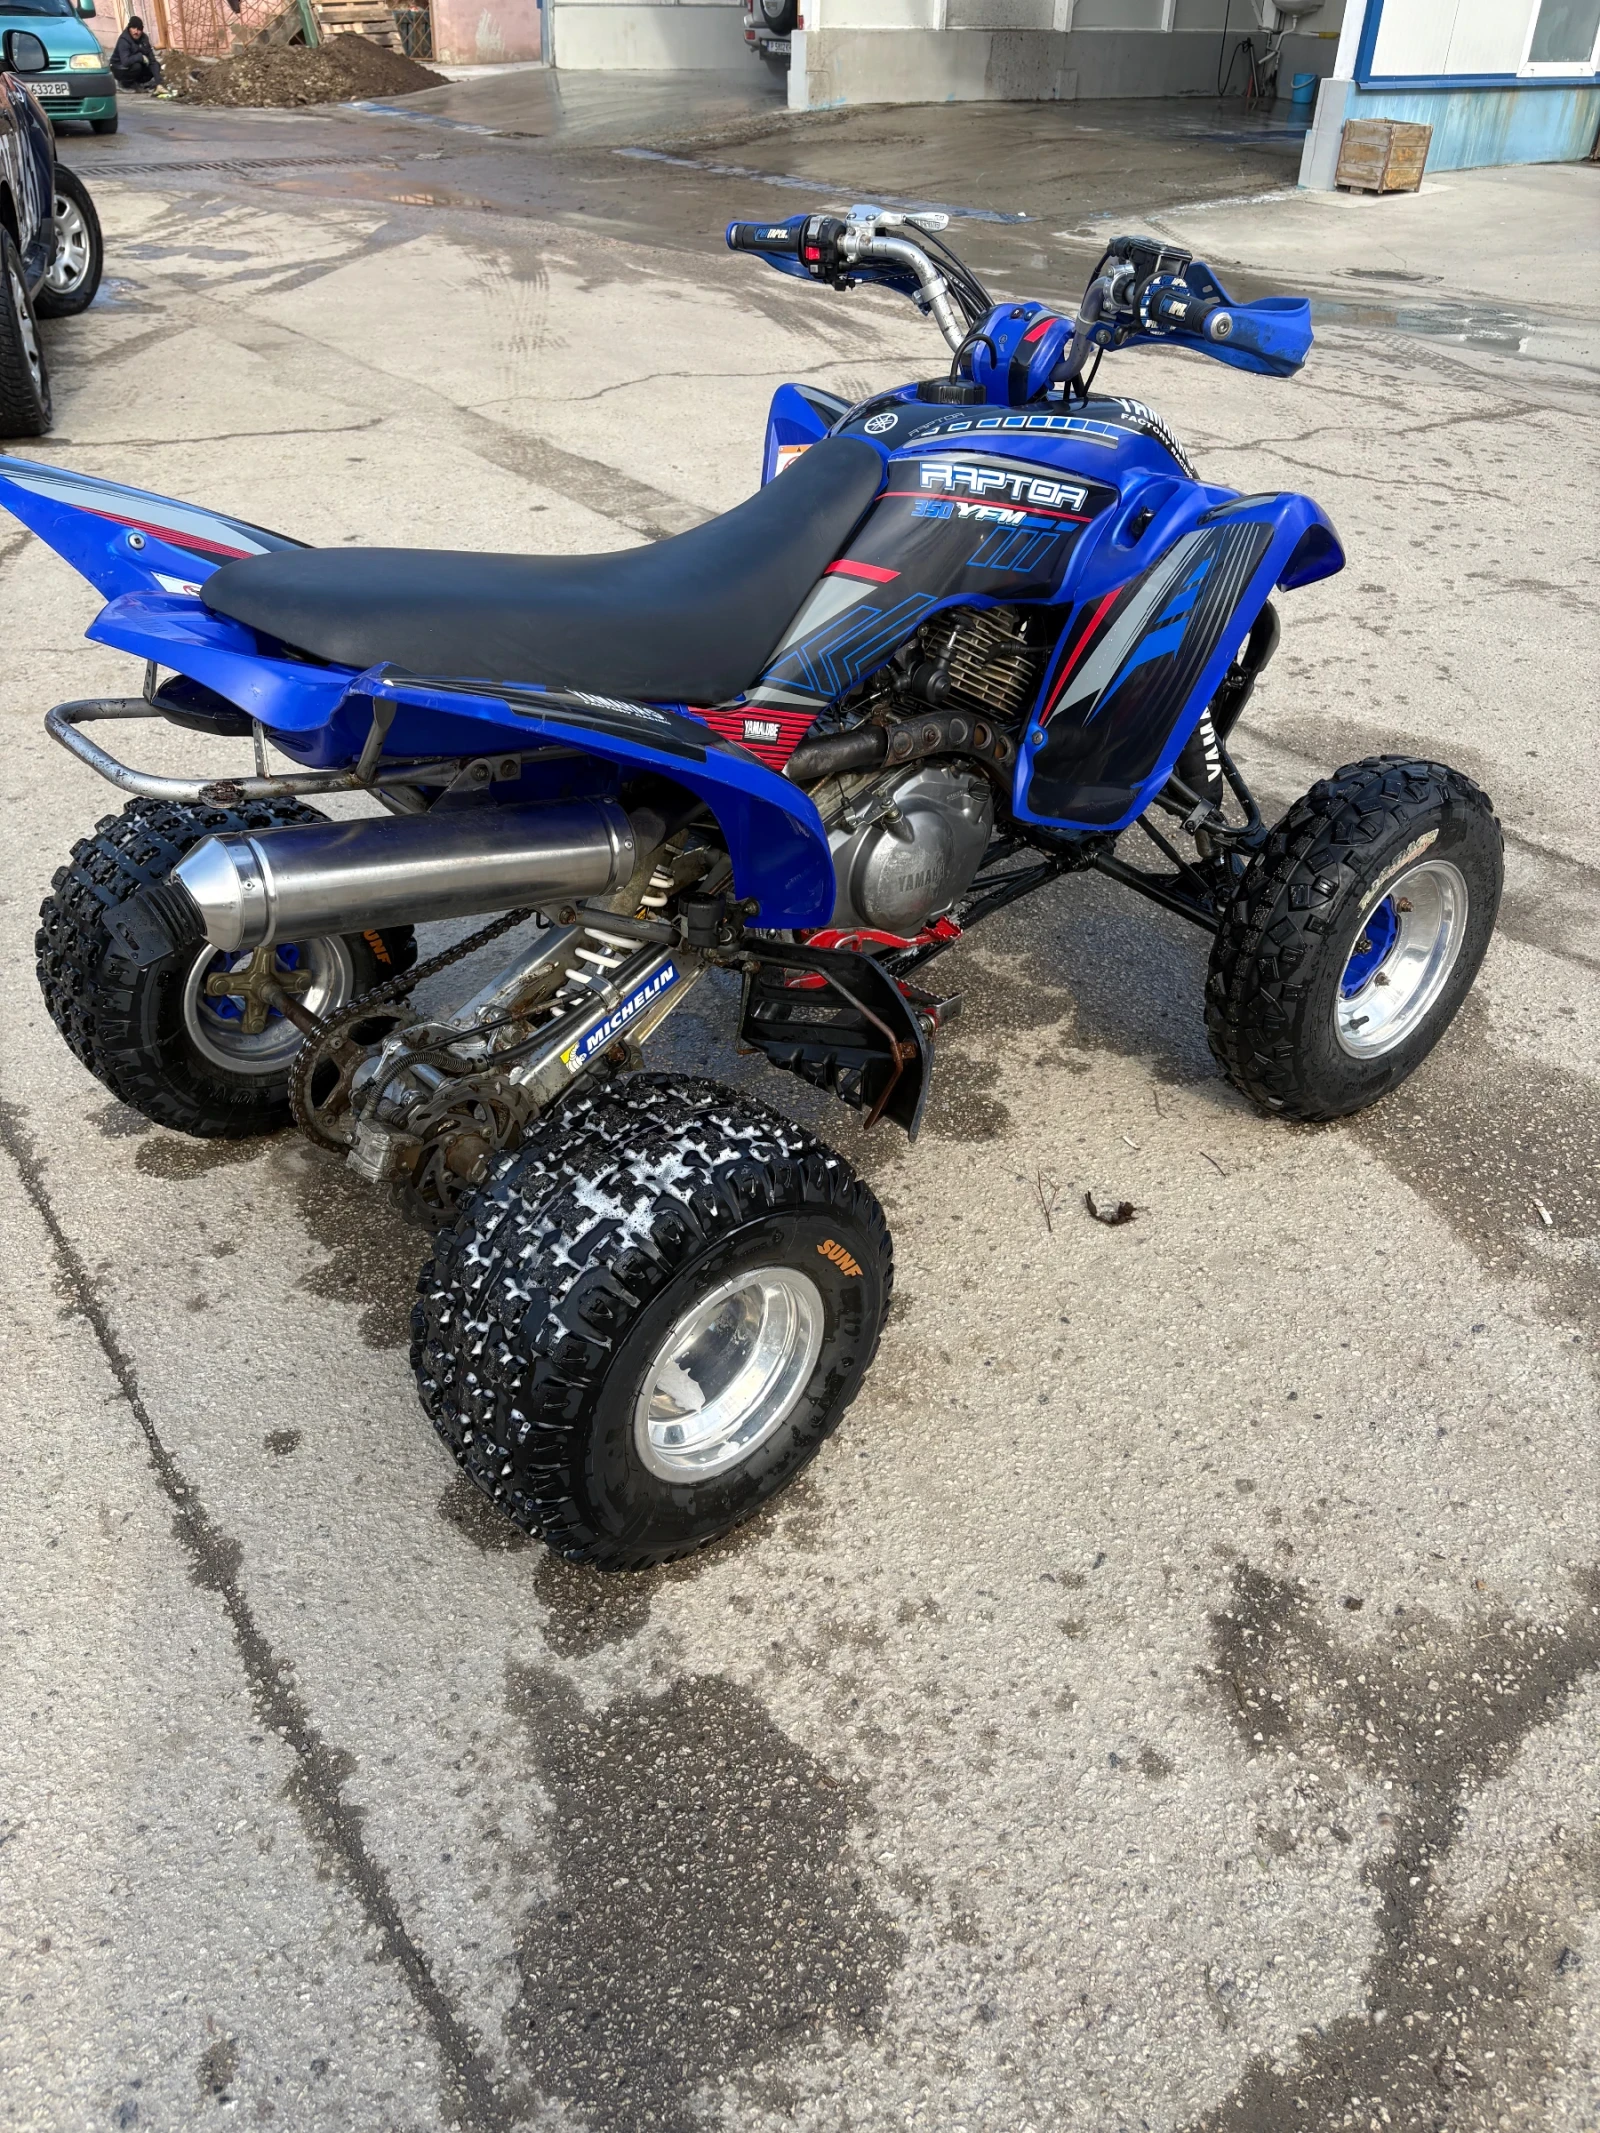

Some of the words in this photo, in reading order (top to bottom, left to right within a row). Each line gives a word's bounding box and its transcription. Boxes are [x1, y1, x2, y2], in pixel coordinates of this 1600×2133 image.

[1120, 413, 1170, 445] FACTORY
[1170, 446, 1194, 479] RACING
[920, 461, 1088, 511] RAPTOR
[911, 502, 955, 519] 350
[956, 502, 1027, 526] YFM
[744, 719, 781, 737] YAMALUBE
[586, 965, 674, 1052] MICHELIN
[816, 1239, 864, 1277] SUNF
